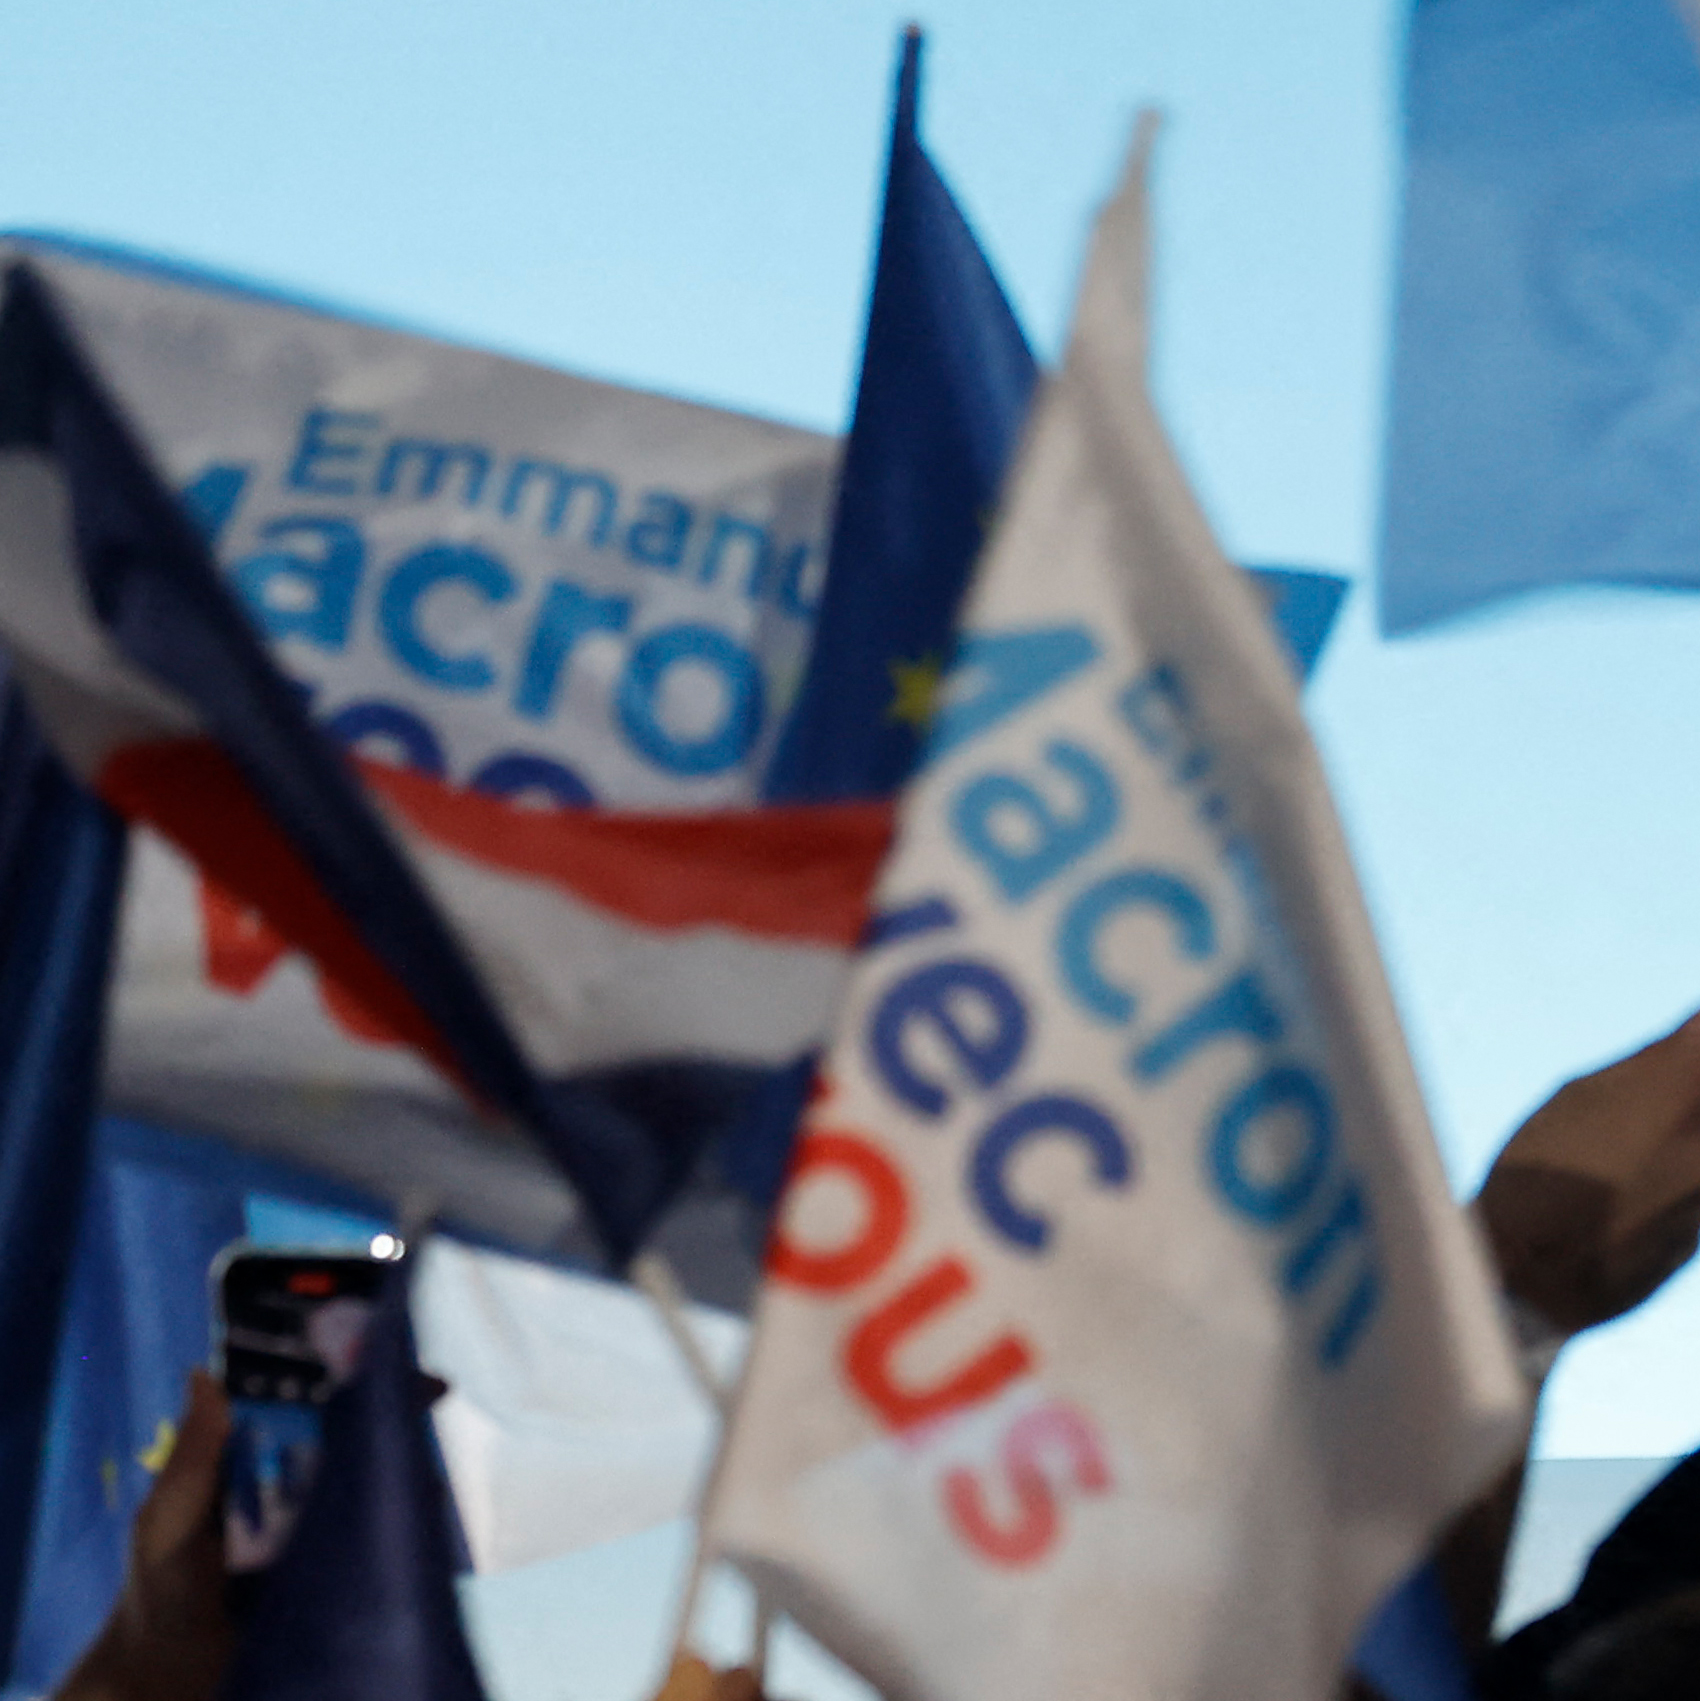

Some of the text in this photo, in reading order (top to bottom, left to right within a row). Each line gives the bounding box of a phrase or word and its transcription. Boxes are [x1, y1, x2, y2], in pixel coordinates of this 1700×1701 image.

[183, 458, 768, 778] acro
[853, 898, 1137, 1256] ec
[763, 1072, 1114, 1572] ous
